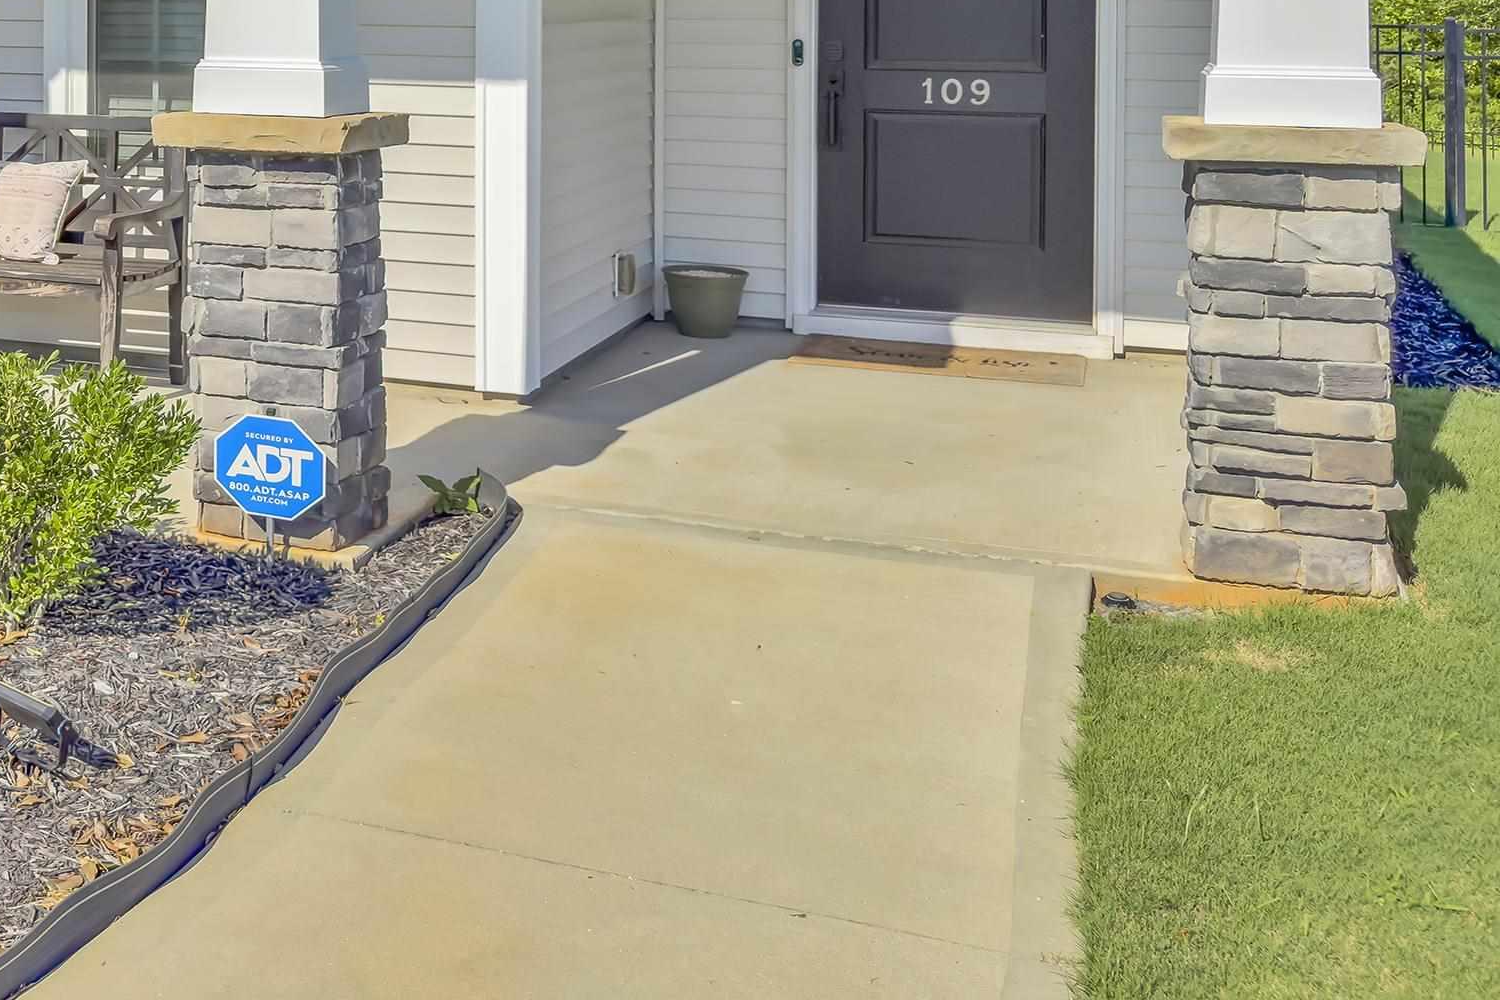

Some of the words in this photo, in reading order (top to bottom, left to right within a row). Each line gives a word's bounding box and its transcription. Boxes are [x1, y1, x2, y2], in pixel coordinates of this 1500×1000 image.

[922, 77, 990, 105] 109
[245, 432, 281, 442] SECURED
[226, 443, 314, 487] ADT
[229, 481, 310, 501] 800.ADT.ASAP
[251, 495, 288, 506] ADT.COM
